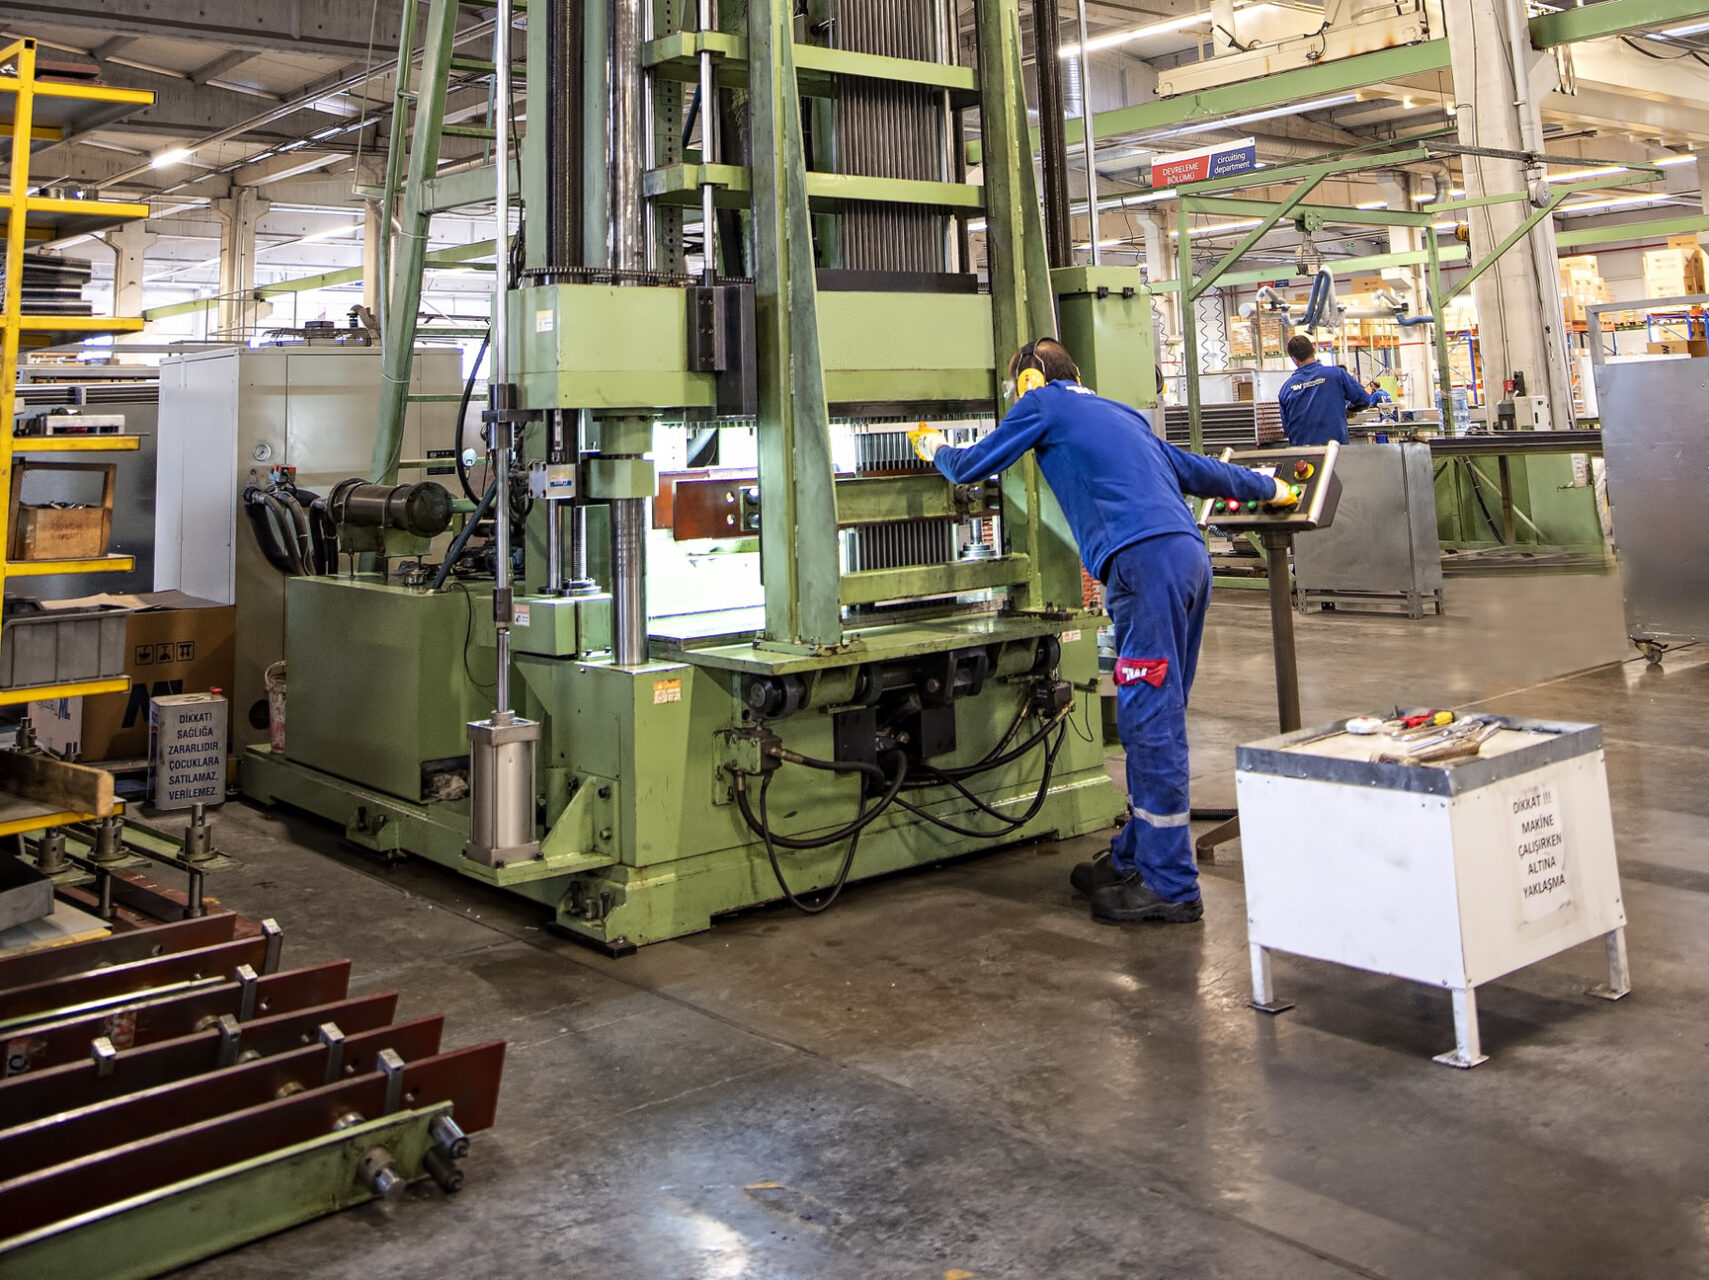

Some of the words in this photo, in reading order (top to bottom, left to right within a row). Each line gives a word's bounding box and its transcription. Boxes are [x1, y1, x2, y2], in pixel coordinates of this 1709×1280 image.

[1217, 152, 1246, 164] circuiting
[1162, 162, 1199, 176] DEVRELEME
[1214, 161, 1250, 174] department
[1167, 171, 1195, 185] BÖLÜMÜ
[179, 712, 213, 724] DİKKAT!
[177, 726, 213, 739] SAĞLIĞA
[168, 741, 222, 756] ZARARLIDIR.
[169, 756, 220, 772] ÇOCUKLARA
[169, 787, 218, 800] VERİLEMEZ.
[1512, 794, 1541, 815] DİKKAT
[1521, 814, 1555, 834] MAKİNE
[1518, 833, 1562, 859] ÇALIŞIRKEN
[1528, 856, 1557, 876] ALTINA
[1523, 874, 1565, 898] YAKLAŞMA
